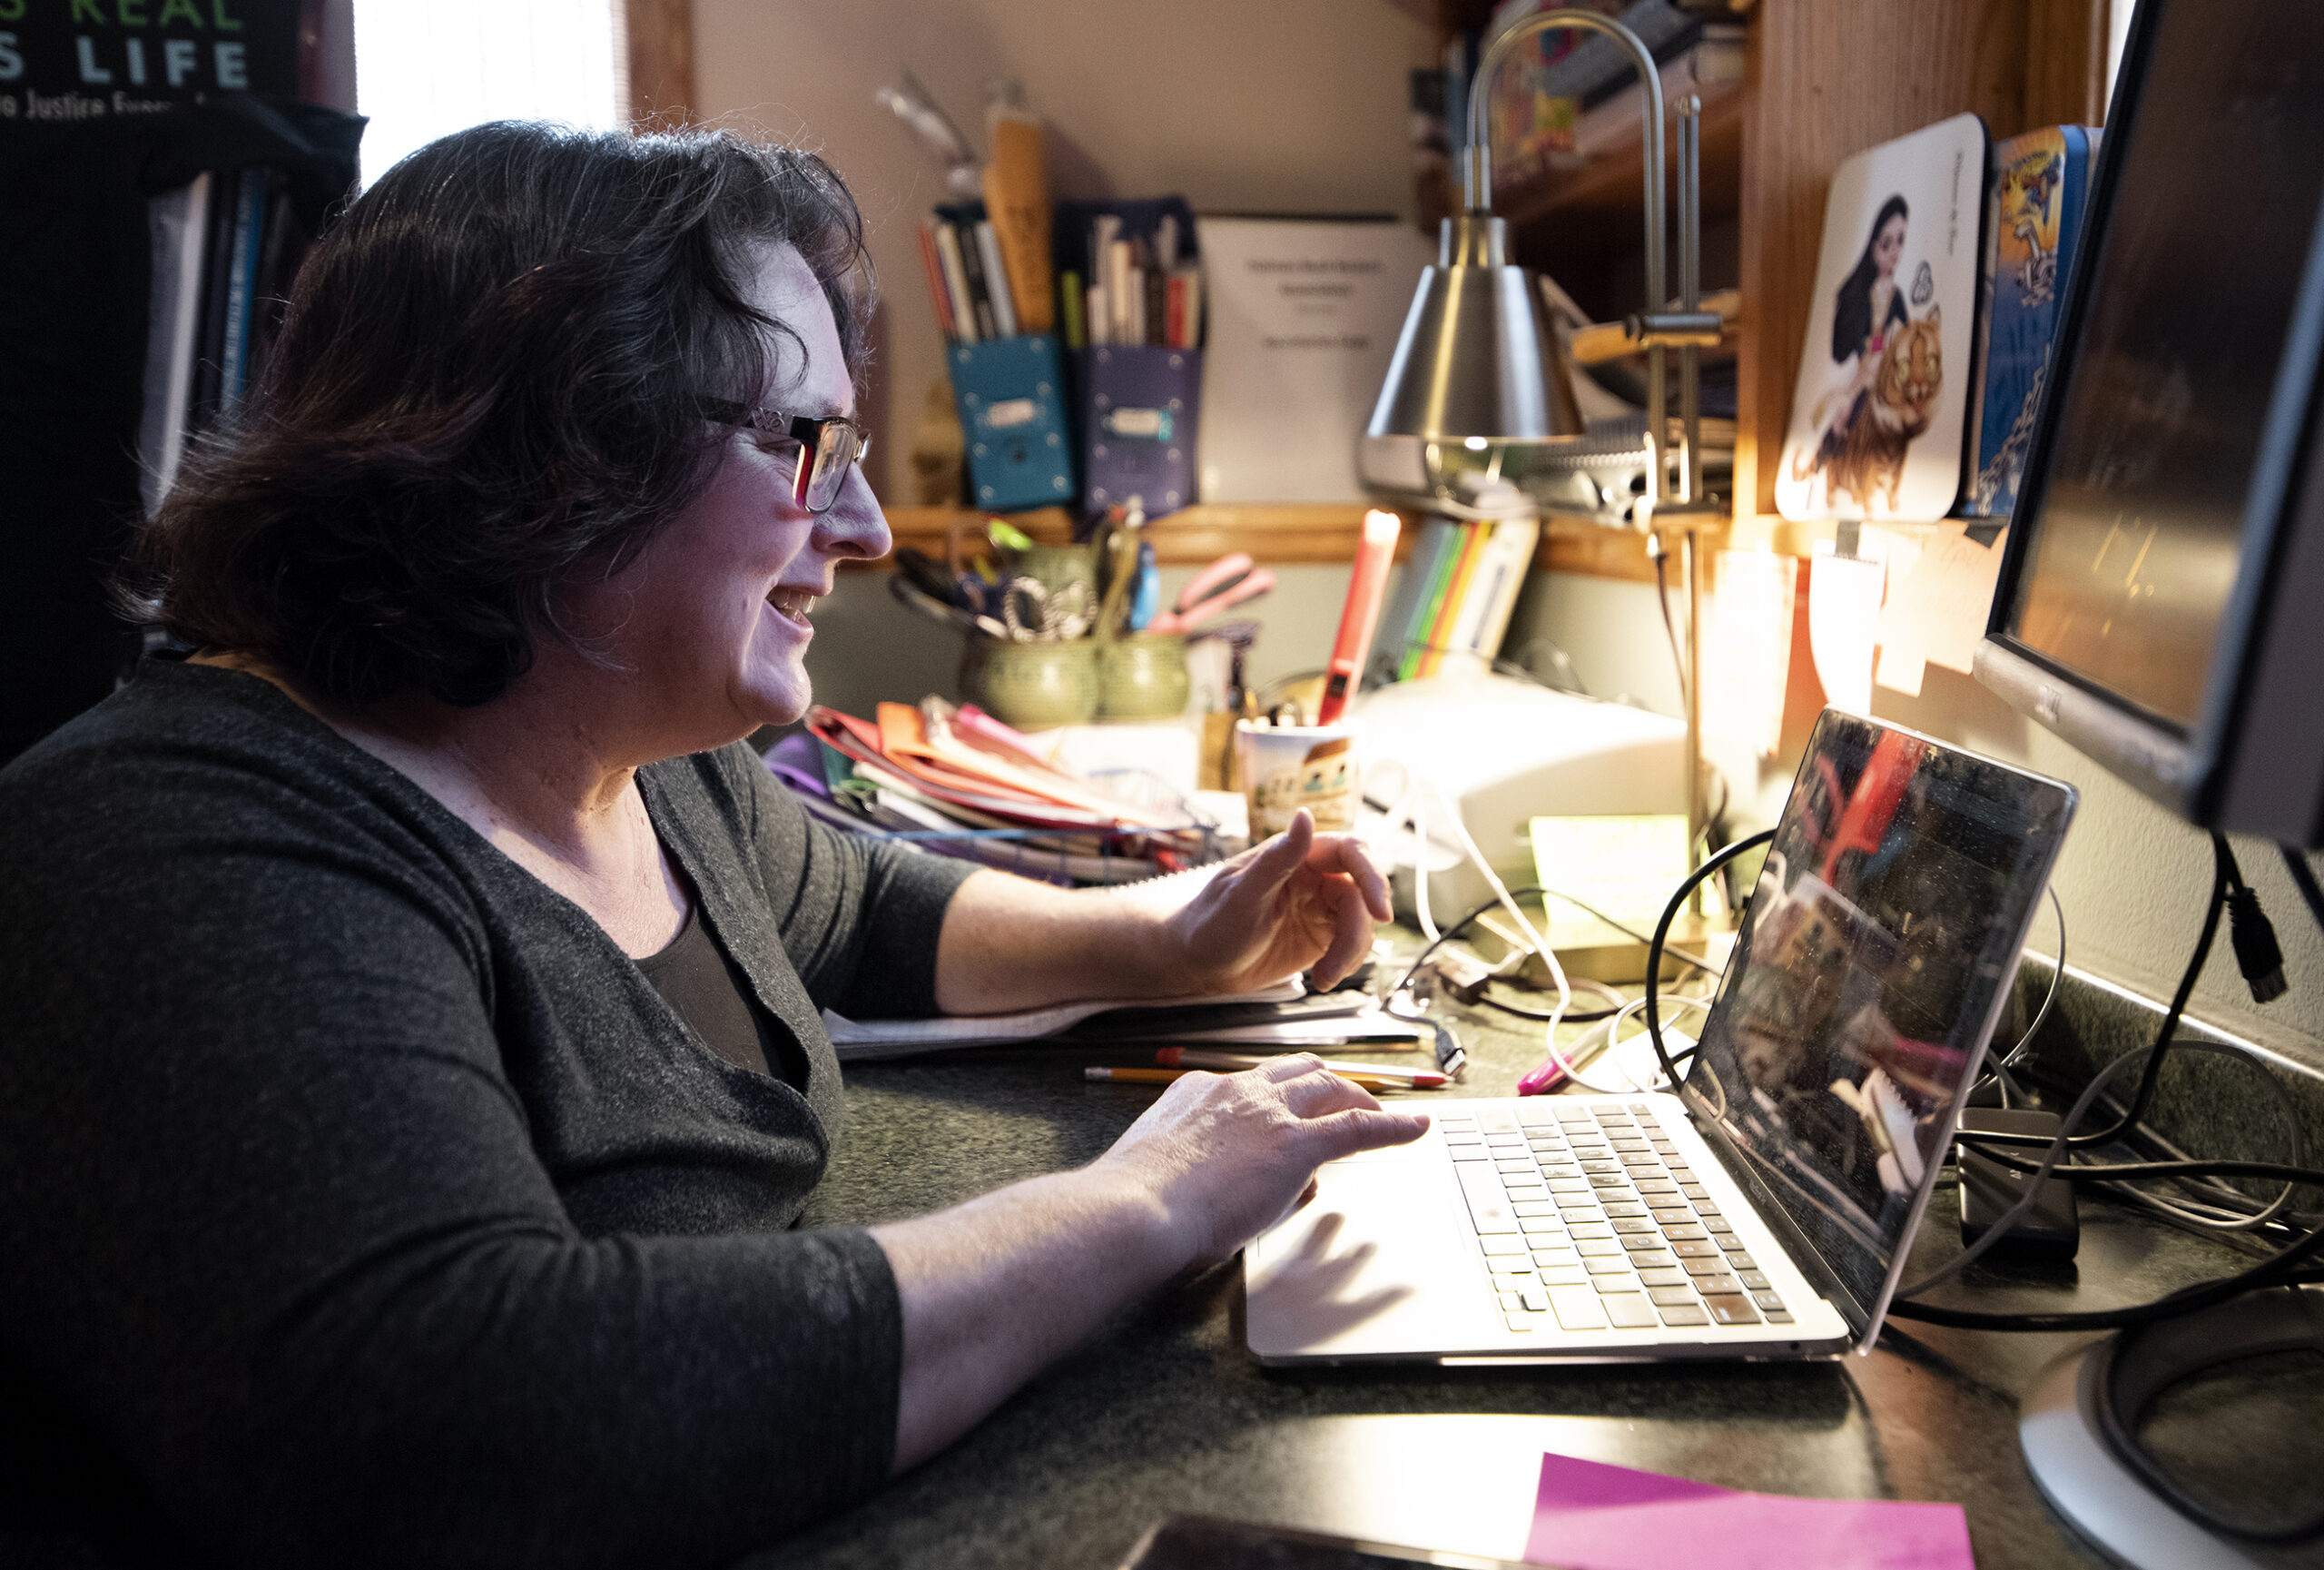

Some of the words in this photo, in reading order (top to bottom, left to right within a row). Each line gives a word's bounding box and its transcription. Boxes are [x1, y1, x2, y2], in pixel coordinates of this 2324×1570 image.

[70, 0, 243, 31] REAL
[76, 35, 249, 88] LIFE
[25, 87, 104, 120] Justice
